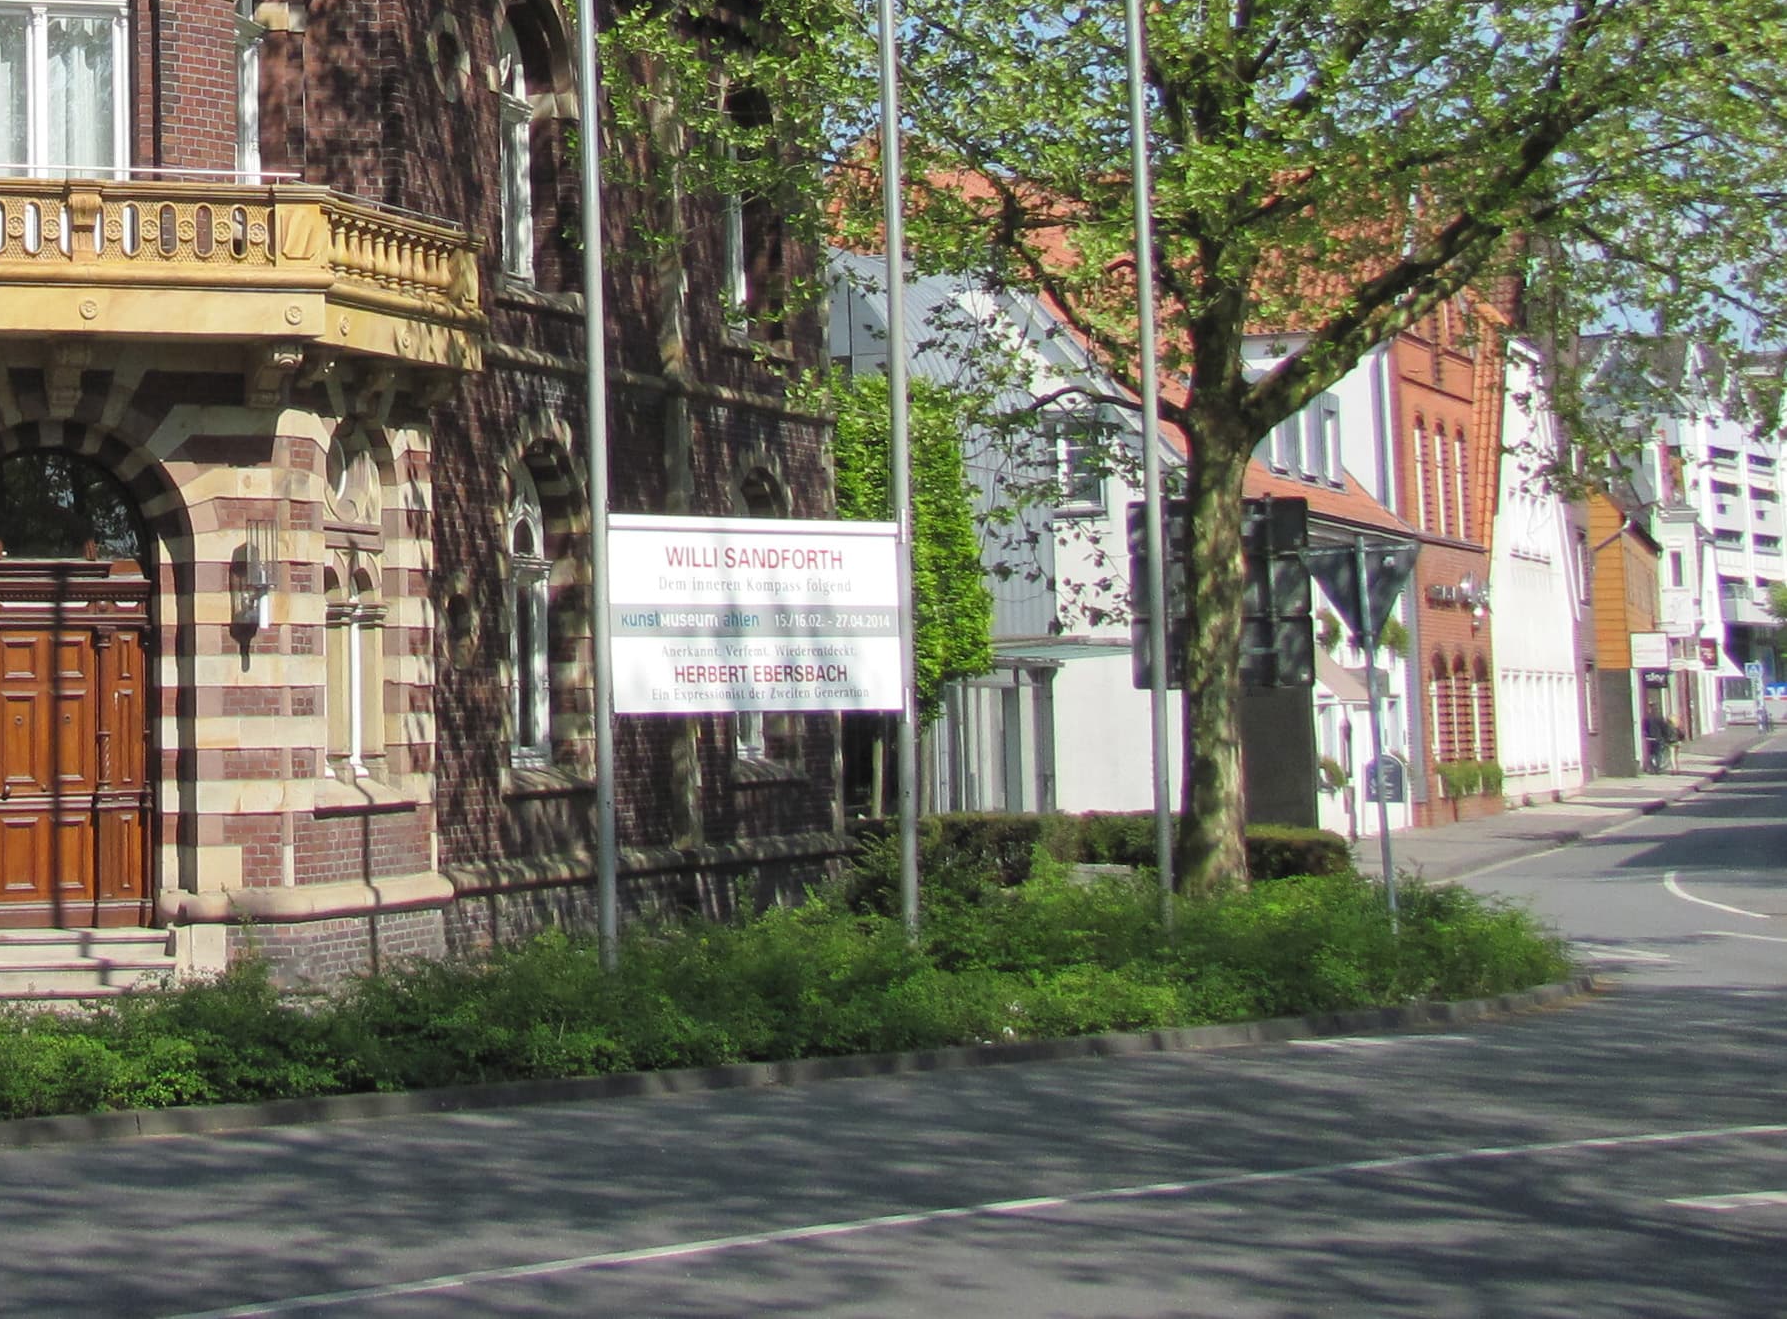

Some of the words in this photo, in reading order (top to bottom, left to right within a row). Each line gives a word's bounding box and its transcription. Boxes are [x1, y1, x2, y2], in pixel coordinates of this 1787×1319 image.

[665, 546, 718, 568] WILLI
[724, 547, 843, 570] SANDFORTH
[658, 576, 687, 591] Dem
[746, 578, 801, 596] Kompass
[806, 578, 852, 596] folgend
[723, 610, 760, 628] ahlen
[835, 614, 891, 628] 27.04.2014
[674, 665, 748, 683] HERBERT
[753, 665, 848, 682] EBERSBACH
[1644, 672, 1665, 684] sky
[652, 688, 669, 701] Ein
[674, 688, 745, 702] Expressionist
[749, 688, 765, 699] der
[814, 687, 870, 699] Generation
